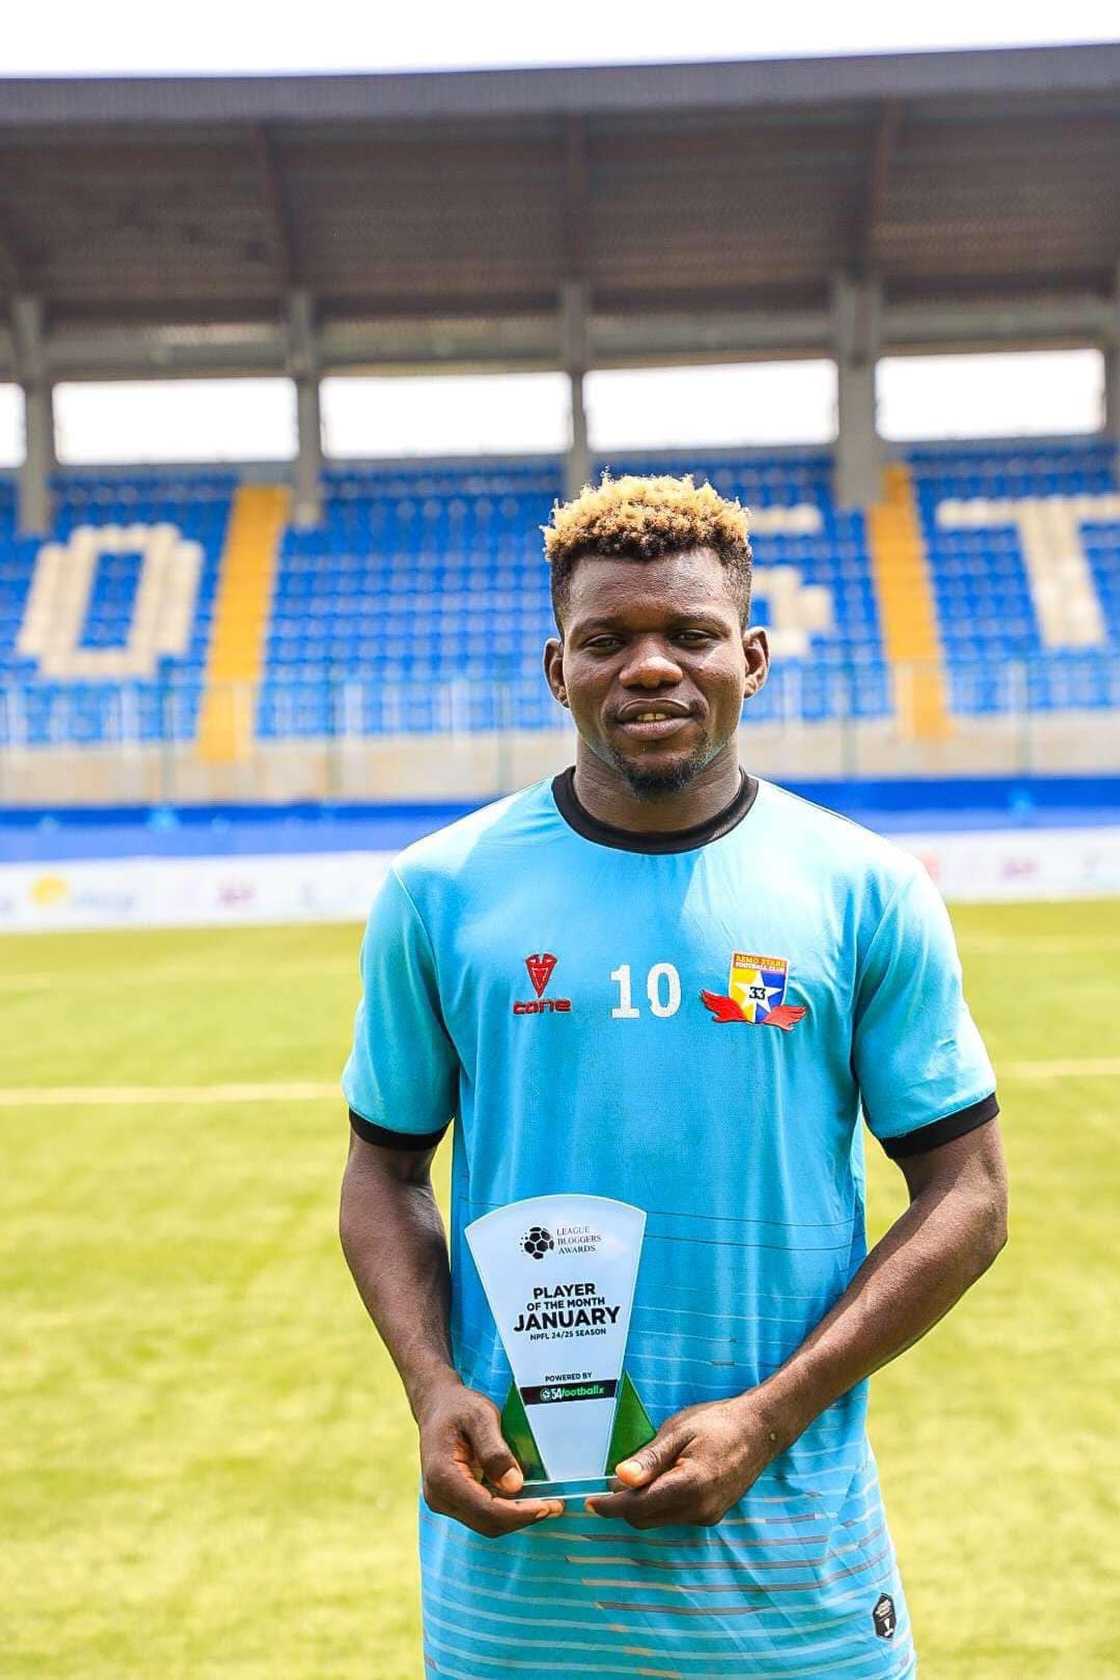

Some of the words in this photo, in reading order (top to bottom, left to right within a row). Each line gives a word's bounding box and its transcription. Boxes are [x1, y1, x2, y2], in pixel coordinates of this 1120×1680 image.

[610, 963, 682, 1018] 10
[749, 987, 766, 999] 33
[556, 1226, 591, 1235] LEAGUE
[557, 1235, 602, 1245] BLOGGERS
[558, 1244, 596, 1254] AWARDS
[533, 1283, 596, 1299] PLAYER
[526, 1302, 541, 1311] OF
[544, 1300, 564, 1310] THE
[567, 1297, 605, 1308] MONTH
[513, 1306, 620, 1332] JANUARY
[530, 1332, 549, 1341] NPFL
[552, 1330, 574, 1339] 24/25
[576, 1328, 606, 1337] SEASON
[545, 1373, 581, 1381] POWERED
